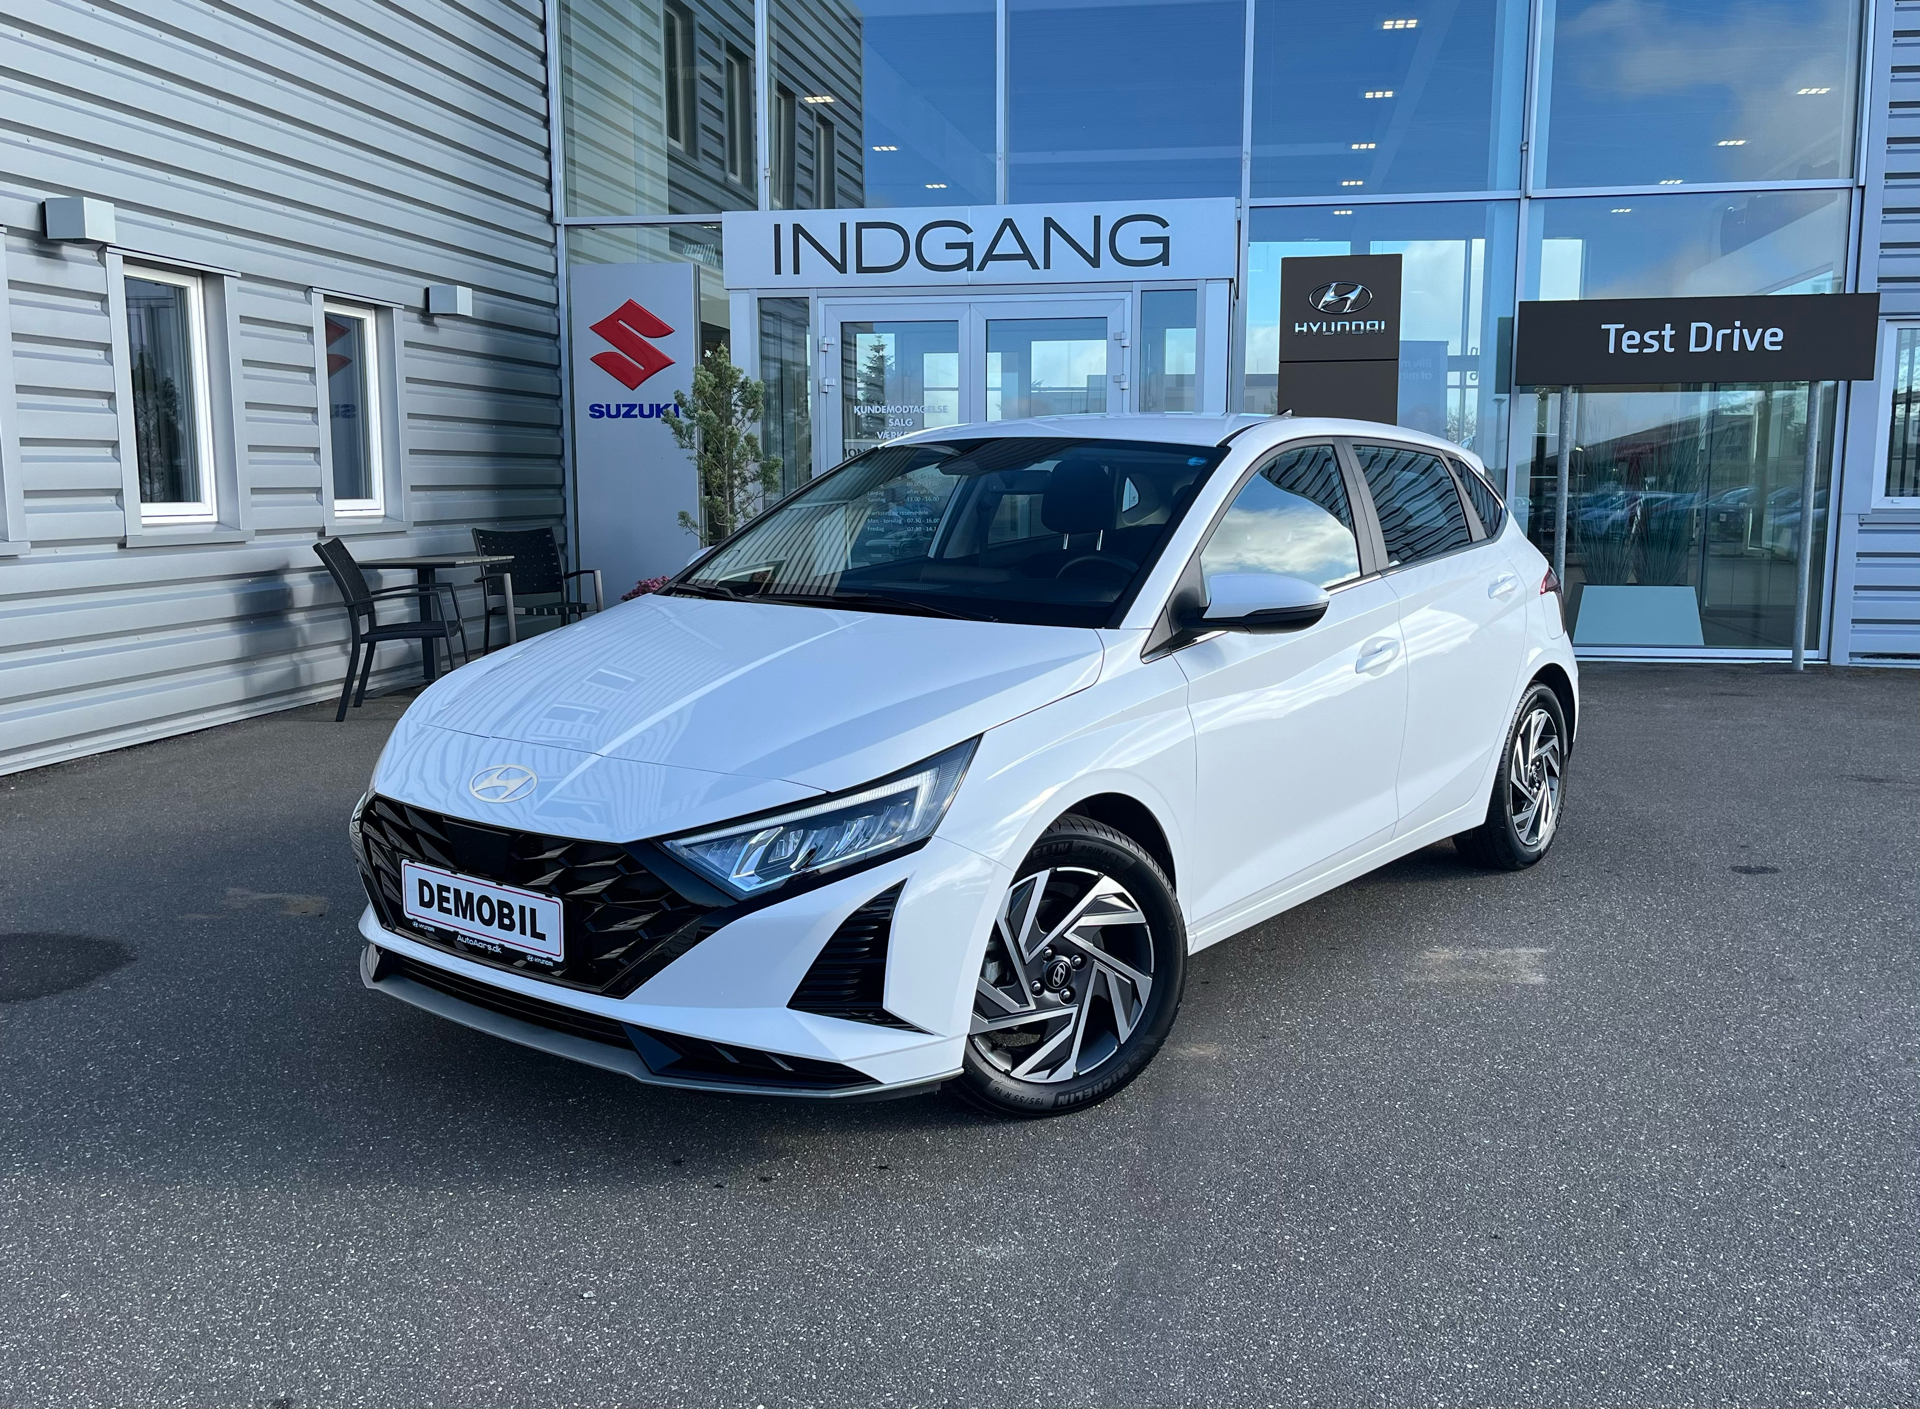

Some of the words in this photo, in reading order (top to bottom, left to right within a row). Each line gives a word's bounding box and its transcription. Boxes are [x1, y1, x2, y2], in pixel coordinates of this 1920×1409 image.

[773, 214, 1170, 275] INDGANG
[1294, 320, 1386, 335] HYUNDAI
[1601, 323, 1676, 354] Test
[1689, 320, 1784, 352] Drive
[588, 403, 680, 419] SUZUKI
[888, 418, 914, 427] SALG
[417, 878, 547, 942] DEMOBIL
[456, 934, 502, 954] AutoAars.dk
[993, 1086, 1003, 1094] 16
[1057, 1063, 1130, 1106] MICHELIN
[1012, 1094, 1044, 1105] 195/55
